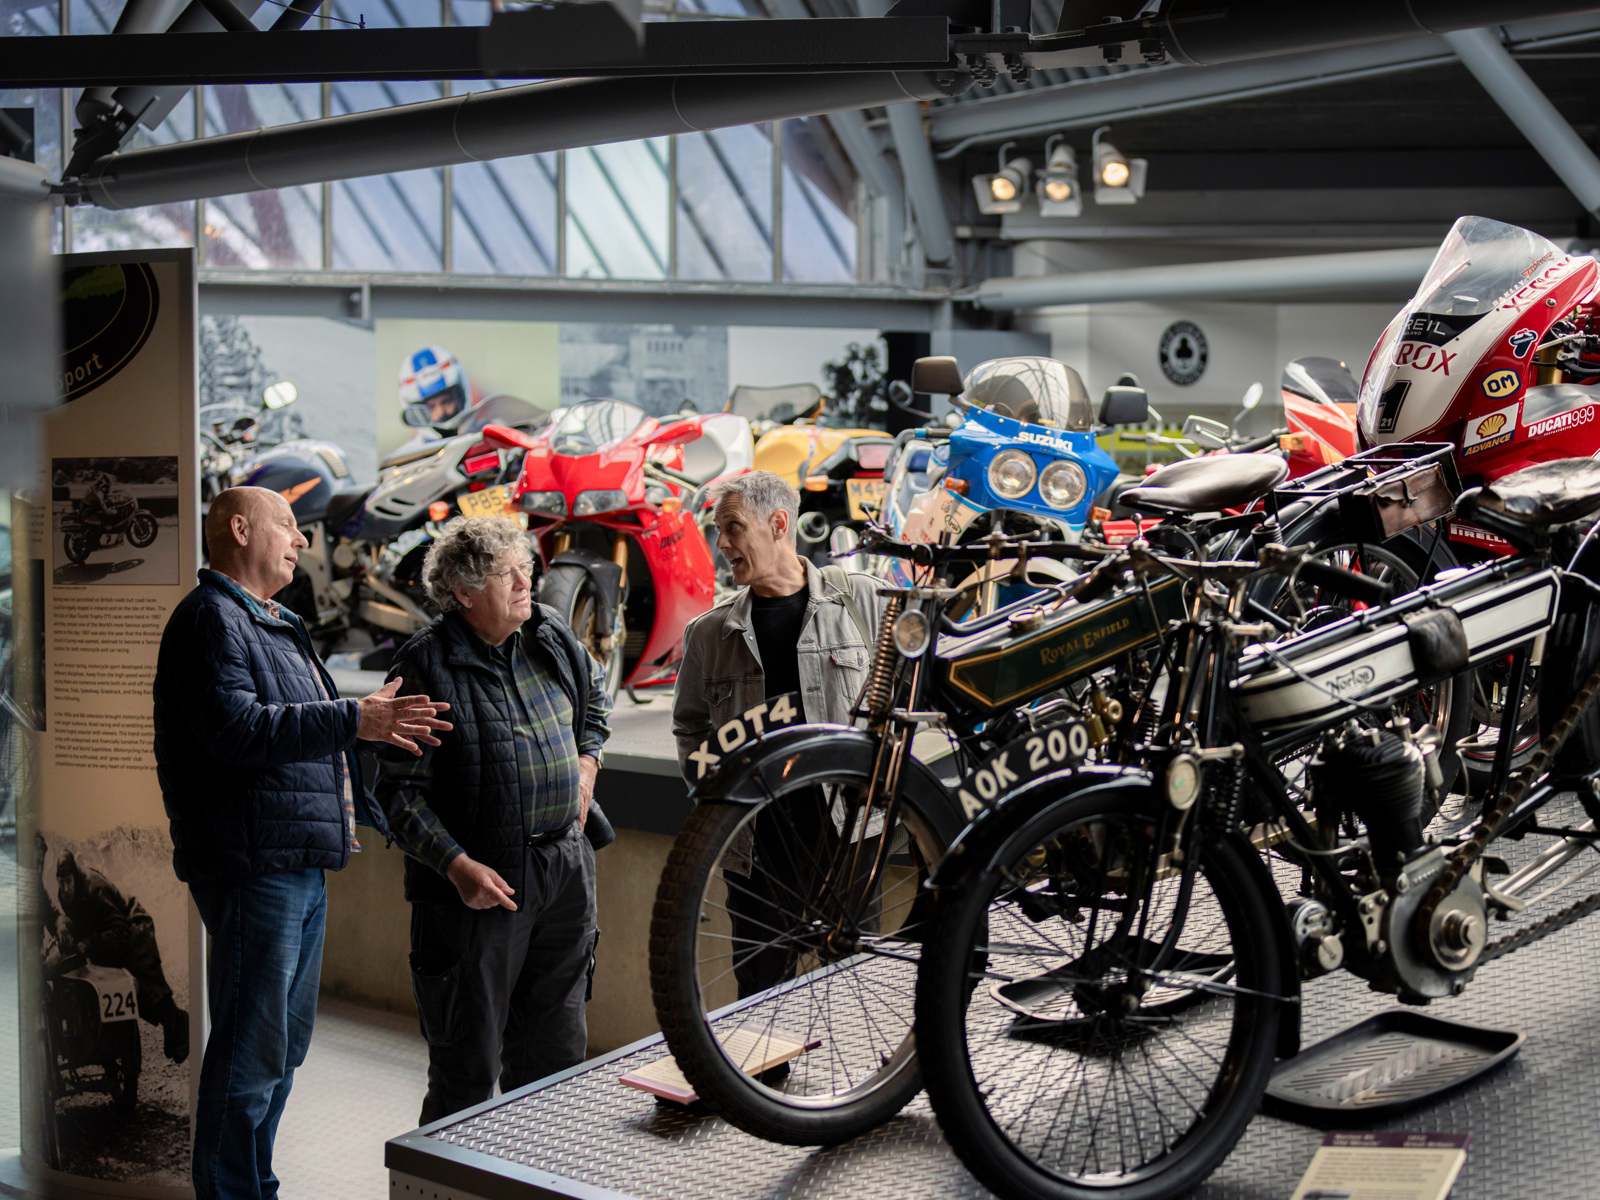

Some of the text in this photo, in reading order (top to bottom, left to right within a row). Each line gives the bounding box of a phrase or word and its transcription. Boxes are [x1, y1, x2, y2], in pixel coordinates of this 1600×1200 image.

[1396, 343, 1458, 376] ROX
[1487, 374, 1515, 393] OM
[1380, 417, 1393, 427] 21
[1528, 405, 1595, 438] DUCATI 999
[1018, 431, 1073, 452] SUZUKI
[1464, 432, 1512, 457] ADVANCE
[1450, 523, 1508, 544] PIRELLI
[1040, 618, 1130, 665] ROYAL ENFIELD
[1326, 665, 1375, 698] Norton
[959, 724, 1088, 820] AOK 200
[102, 991, 136, 1018] 224
